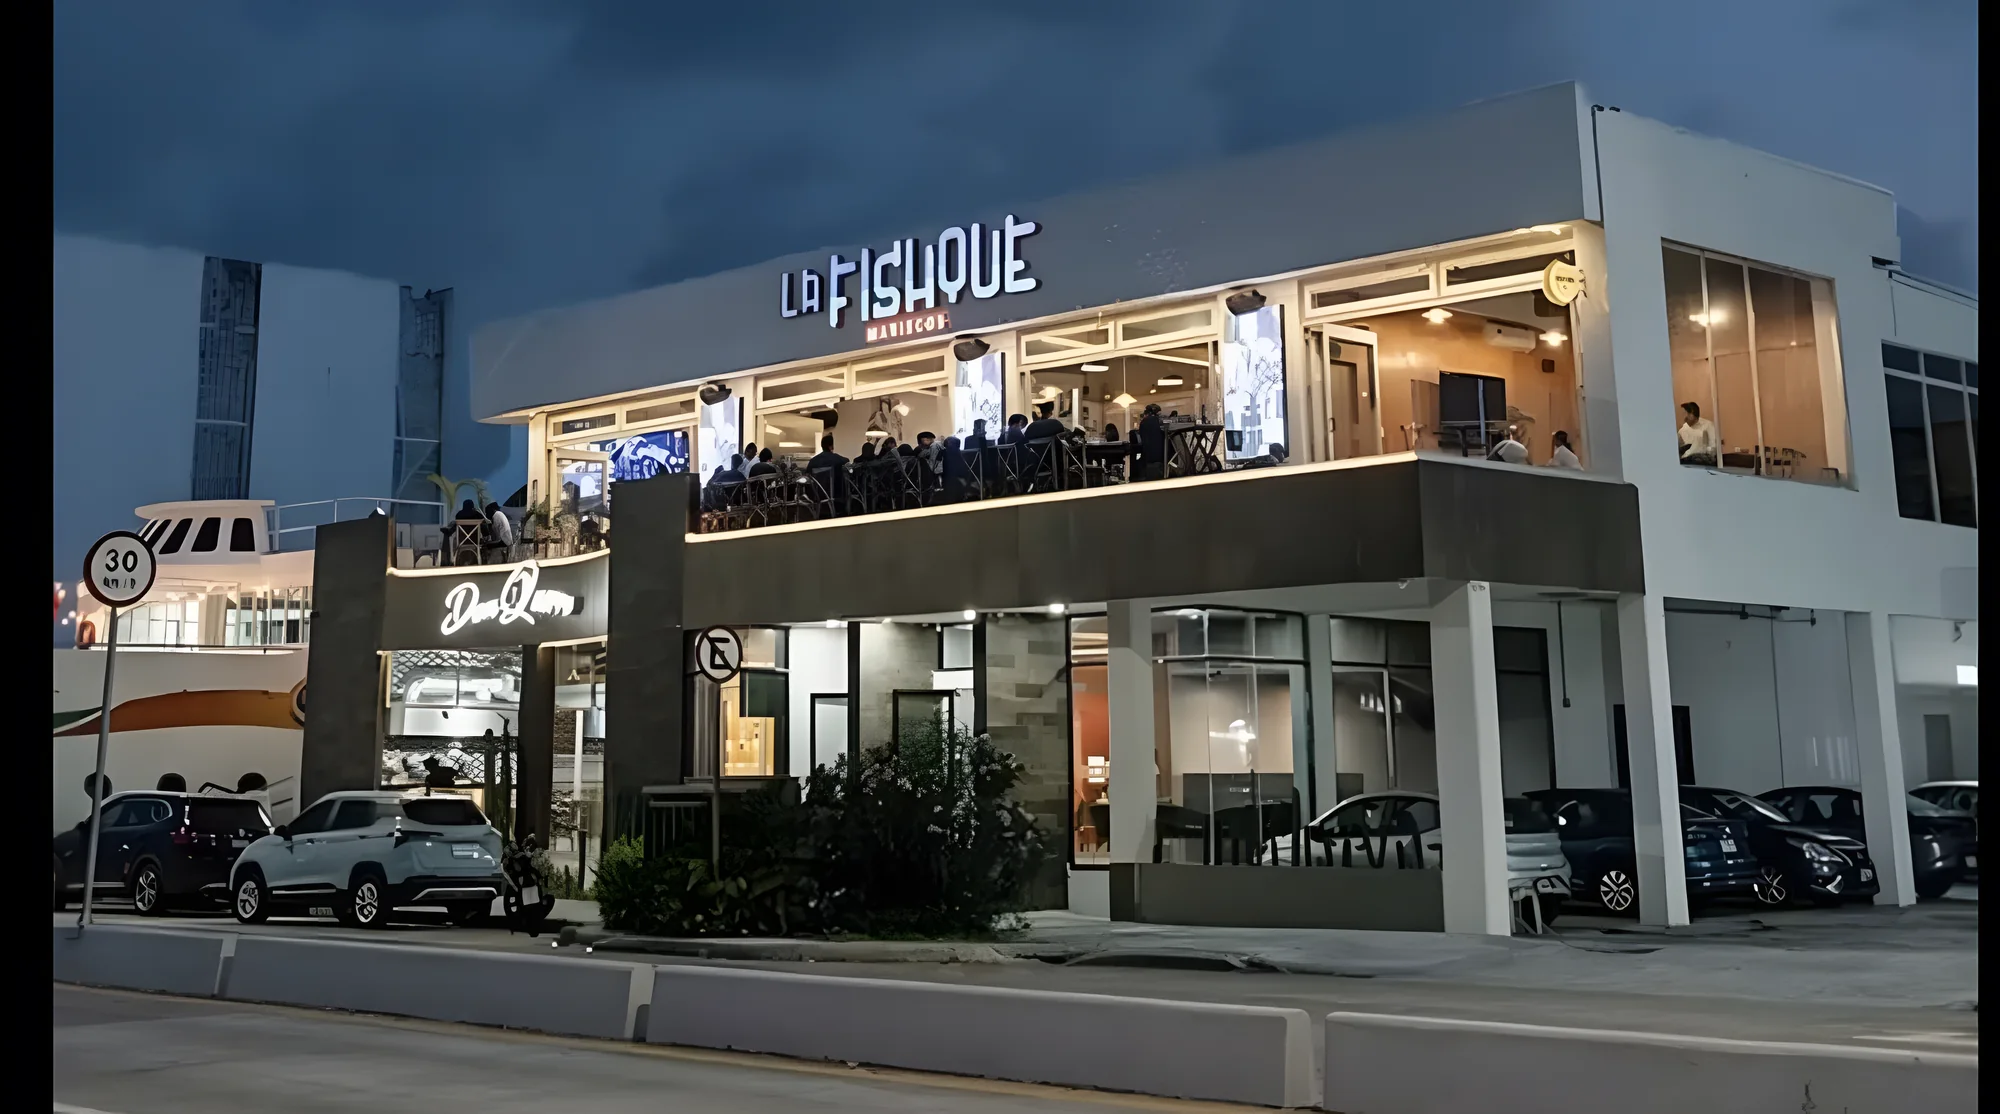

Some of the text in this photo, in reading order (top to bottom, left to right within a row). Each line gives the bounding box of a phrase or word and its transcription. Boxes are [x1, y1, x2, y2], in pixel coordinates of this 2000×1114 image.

[780, 214, 1039, 329] LA FISHQUE
[105, 548, 138, 573] 30
